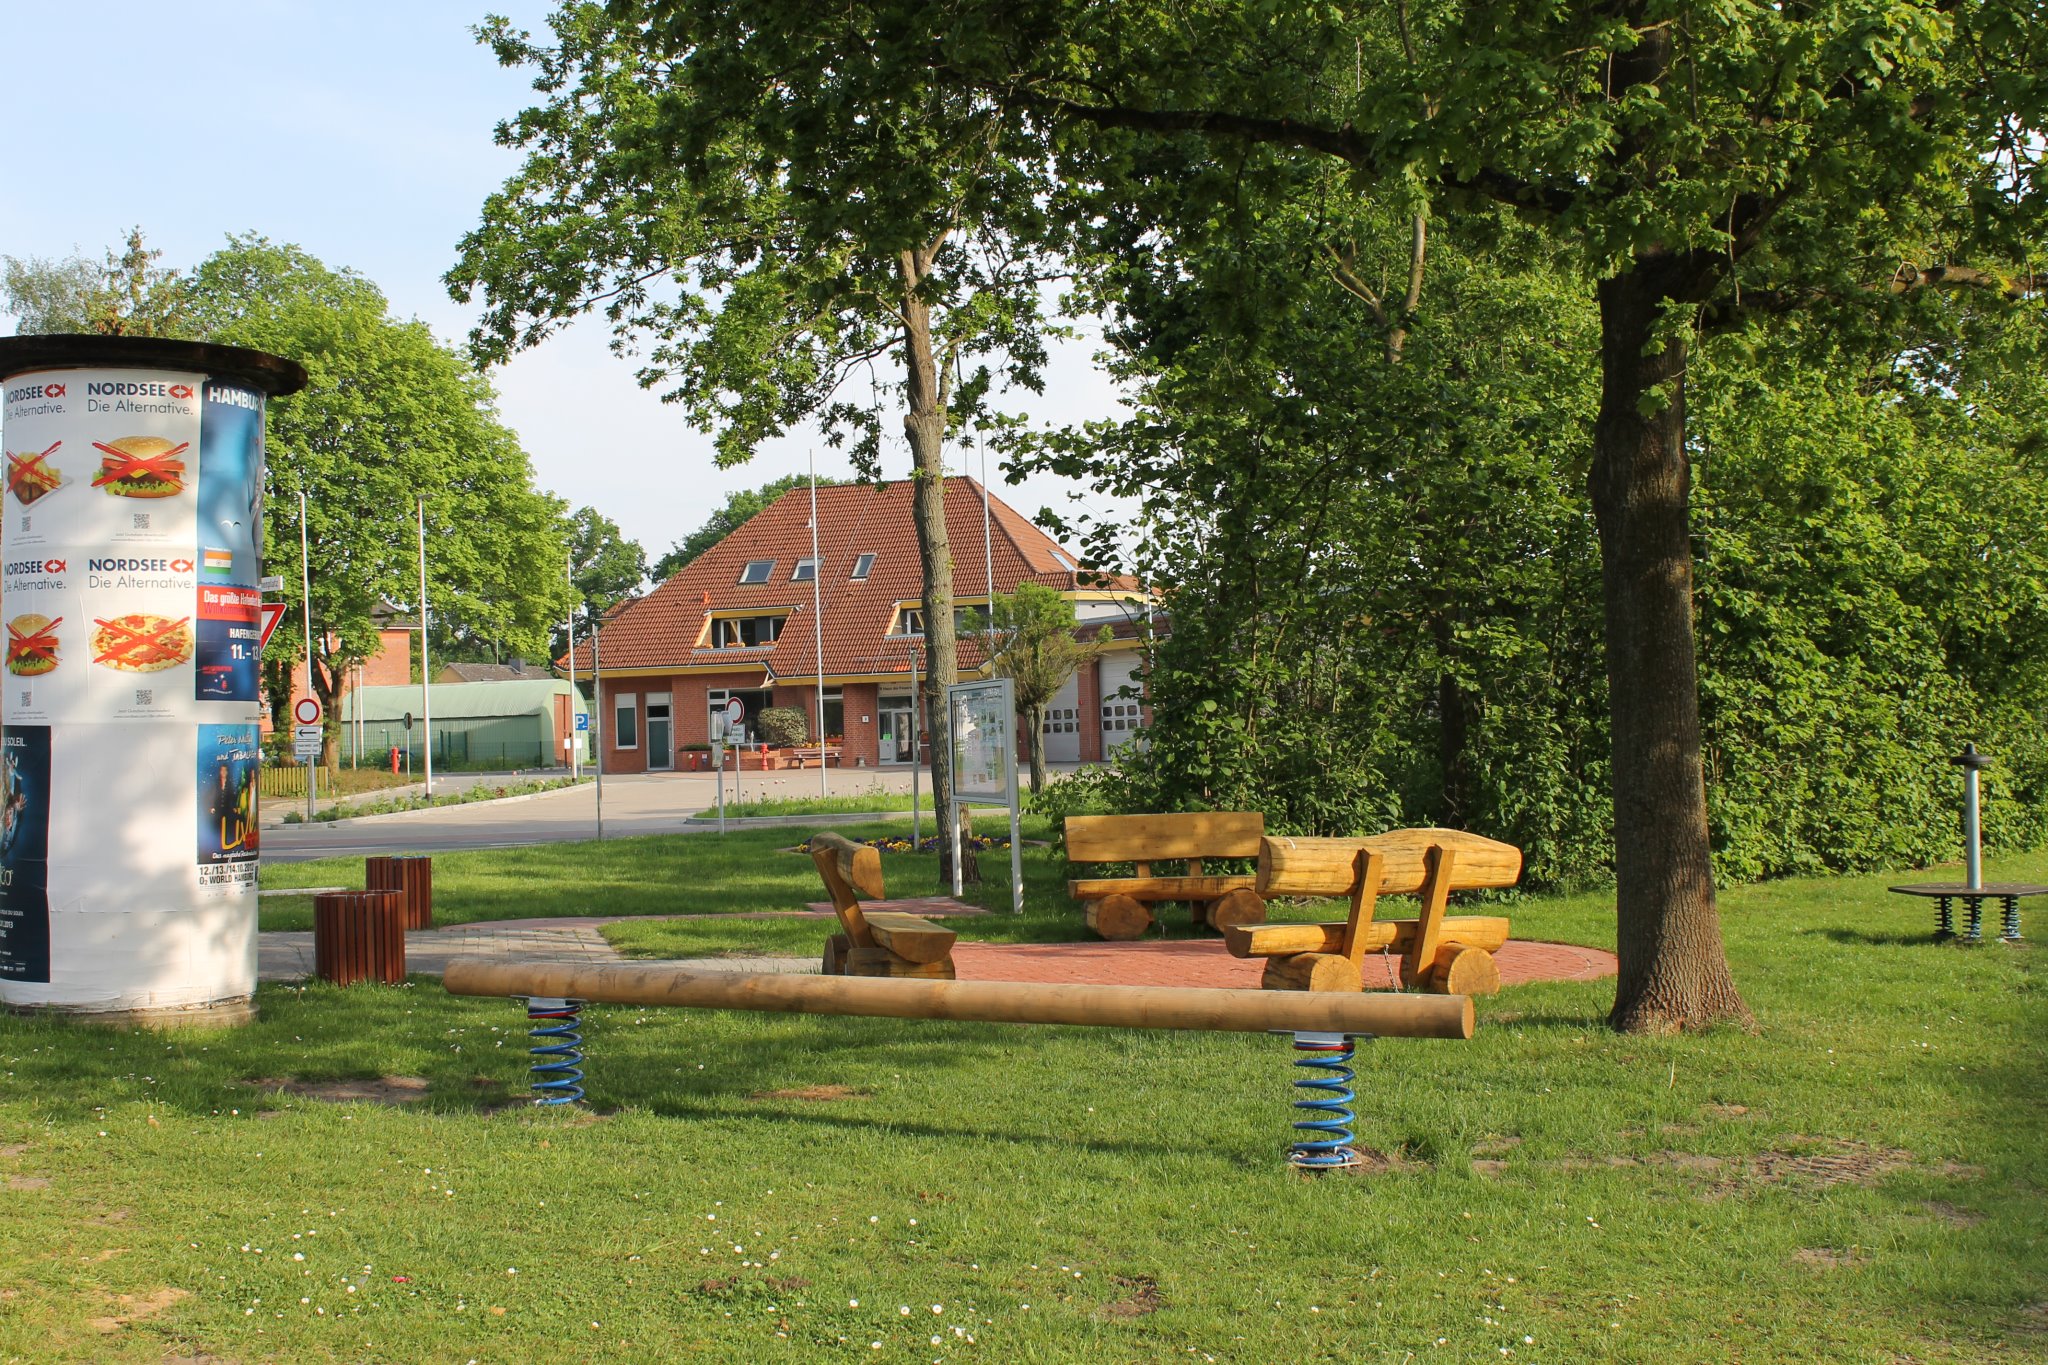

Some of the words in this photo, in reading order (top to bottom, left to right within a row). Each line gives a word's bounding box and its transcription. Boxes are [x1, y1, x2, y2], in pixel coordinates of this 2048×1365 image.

[6, 385, 43, 405] NORDSEE
[88, 382, 166, 397] NORDSEE
[208, 386, 260, 412] HAMBUR
[15, 401, 66, 418] Alternative.
[88, 399, 110, 412] Die
[115, 399, 194, 415] Alternative.
[5, 560, 43, 577] NORDSEE
[89, 558, 167, 572] NORDSEE
[13, 577, 67, 592] Alternative.
[89, 575, 111, 589] Die
[117, 574, 194, 589] Alternative.
[204, 590, 219, 603] Das
[576, 715, 585, 729] P
[209, 874, 233, 885] WORLD
